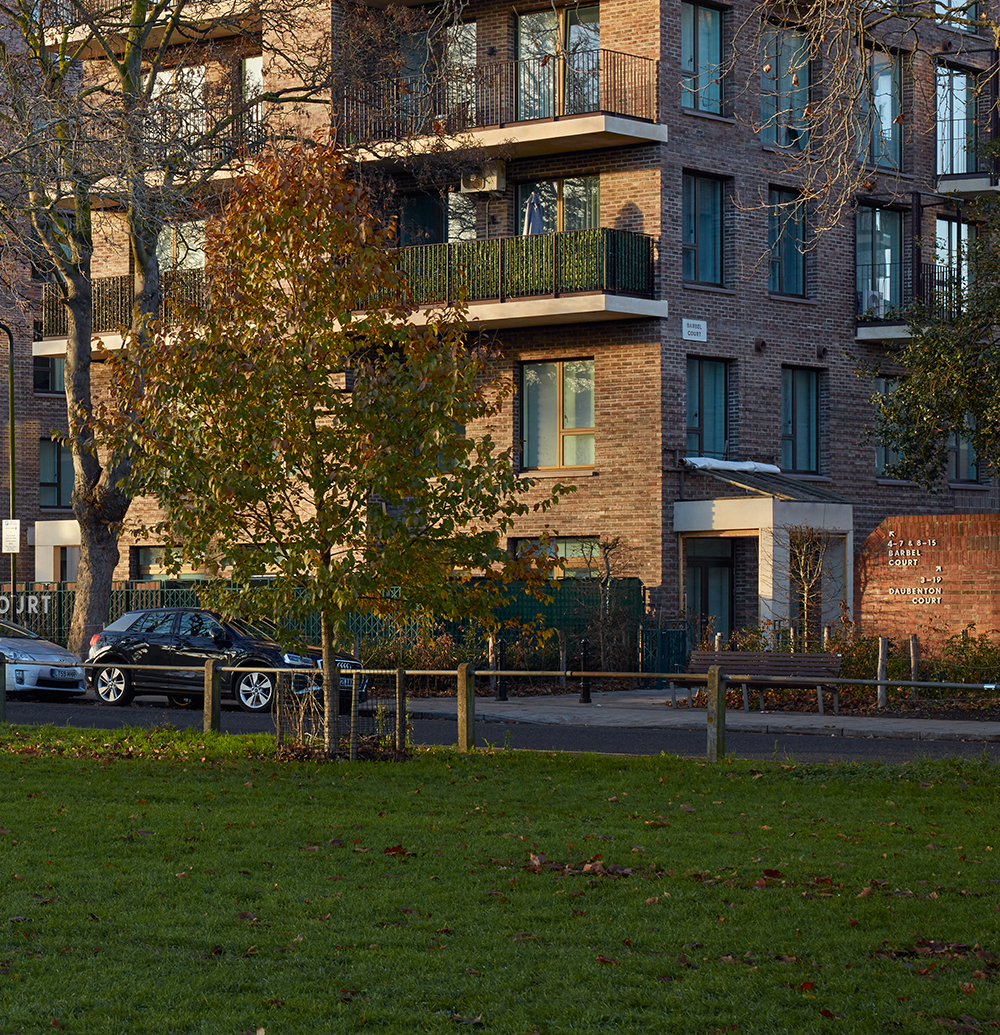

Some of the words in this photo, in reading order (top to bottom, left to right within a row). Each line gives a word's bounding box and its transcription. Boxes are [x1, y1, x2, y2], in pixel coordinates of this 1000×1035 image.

[916, 539, 937, 547] 8-15
[888, 549, 922, 557] BARBEL
[920, 576, 942, 584] 3-19
[888, 587, 942, 595] DAUBENTON
